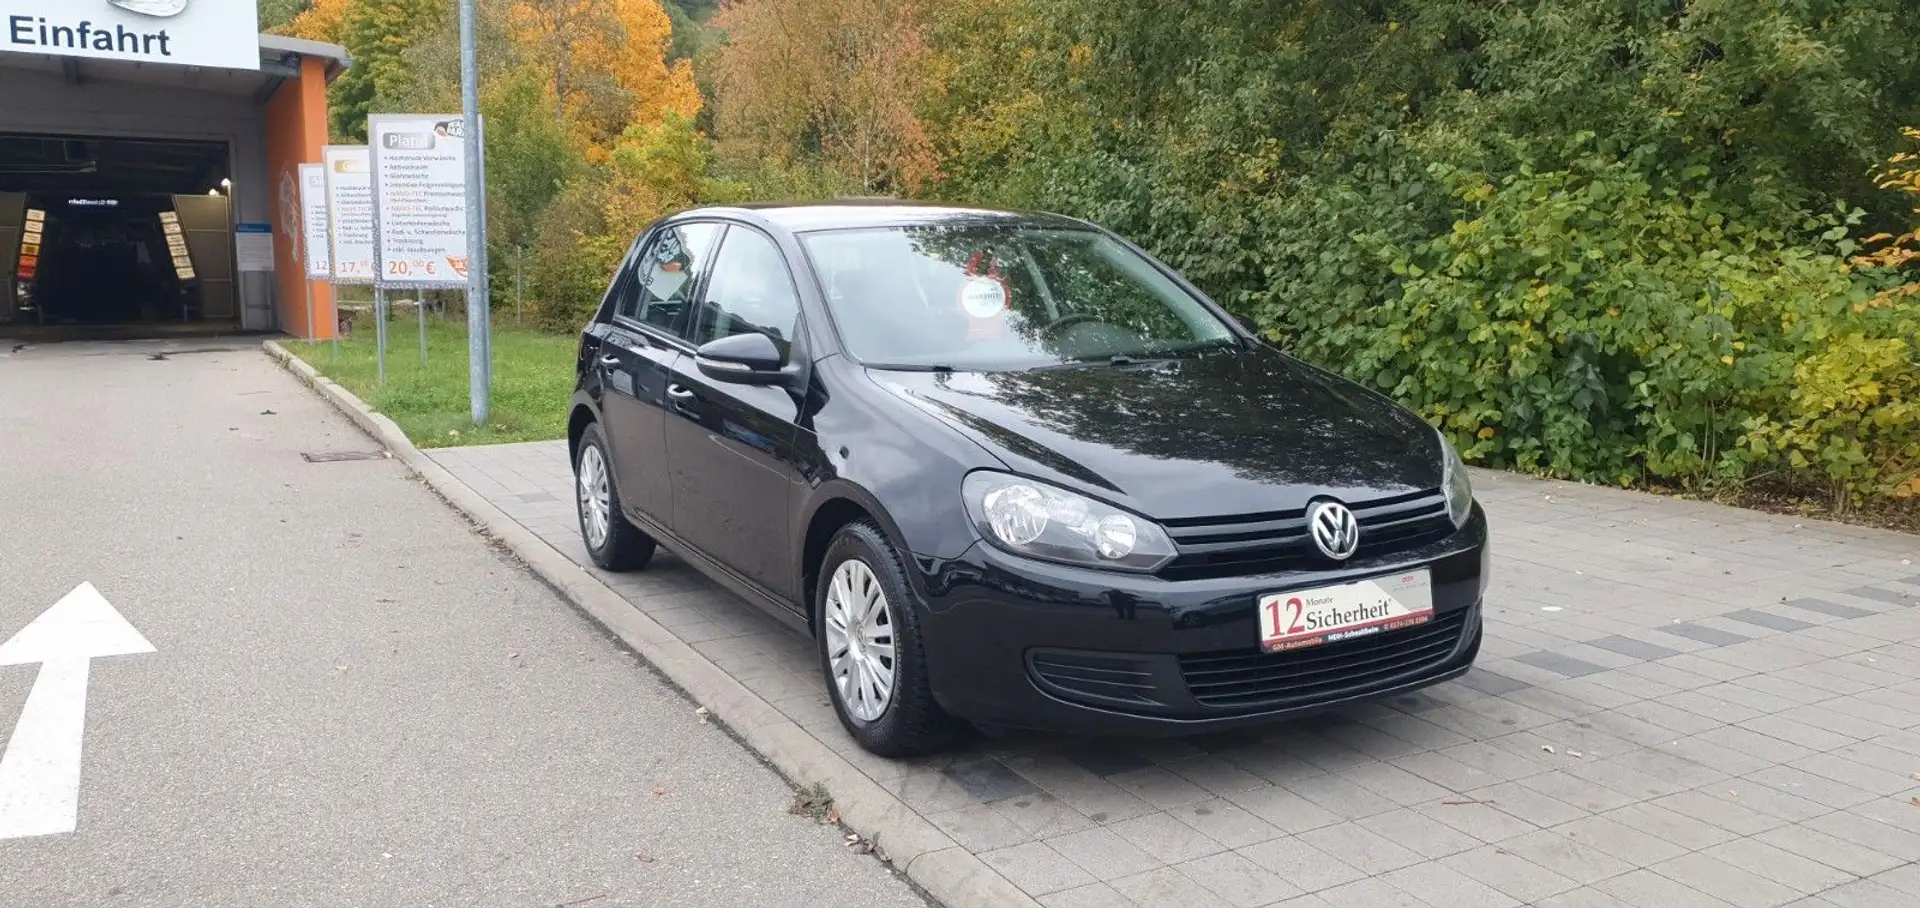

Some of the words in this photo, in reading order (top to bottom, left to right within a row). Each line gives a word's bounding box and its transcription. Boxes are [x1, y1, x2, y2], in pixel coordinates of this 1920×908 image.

[9, 15, 172, 56] Einfahrt
[1265, 595, 1306, 637] 12
[1305, 596, 1334, 607] Monate
